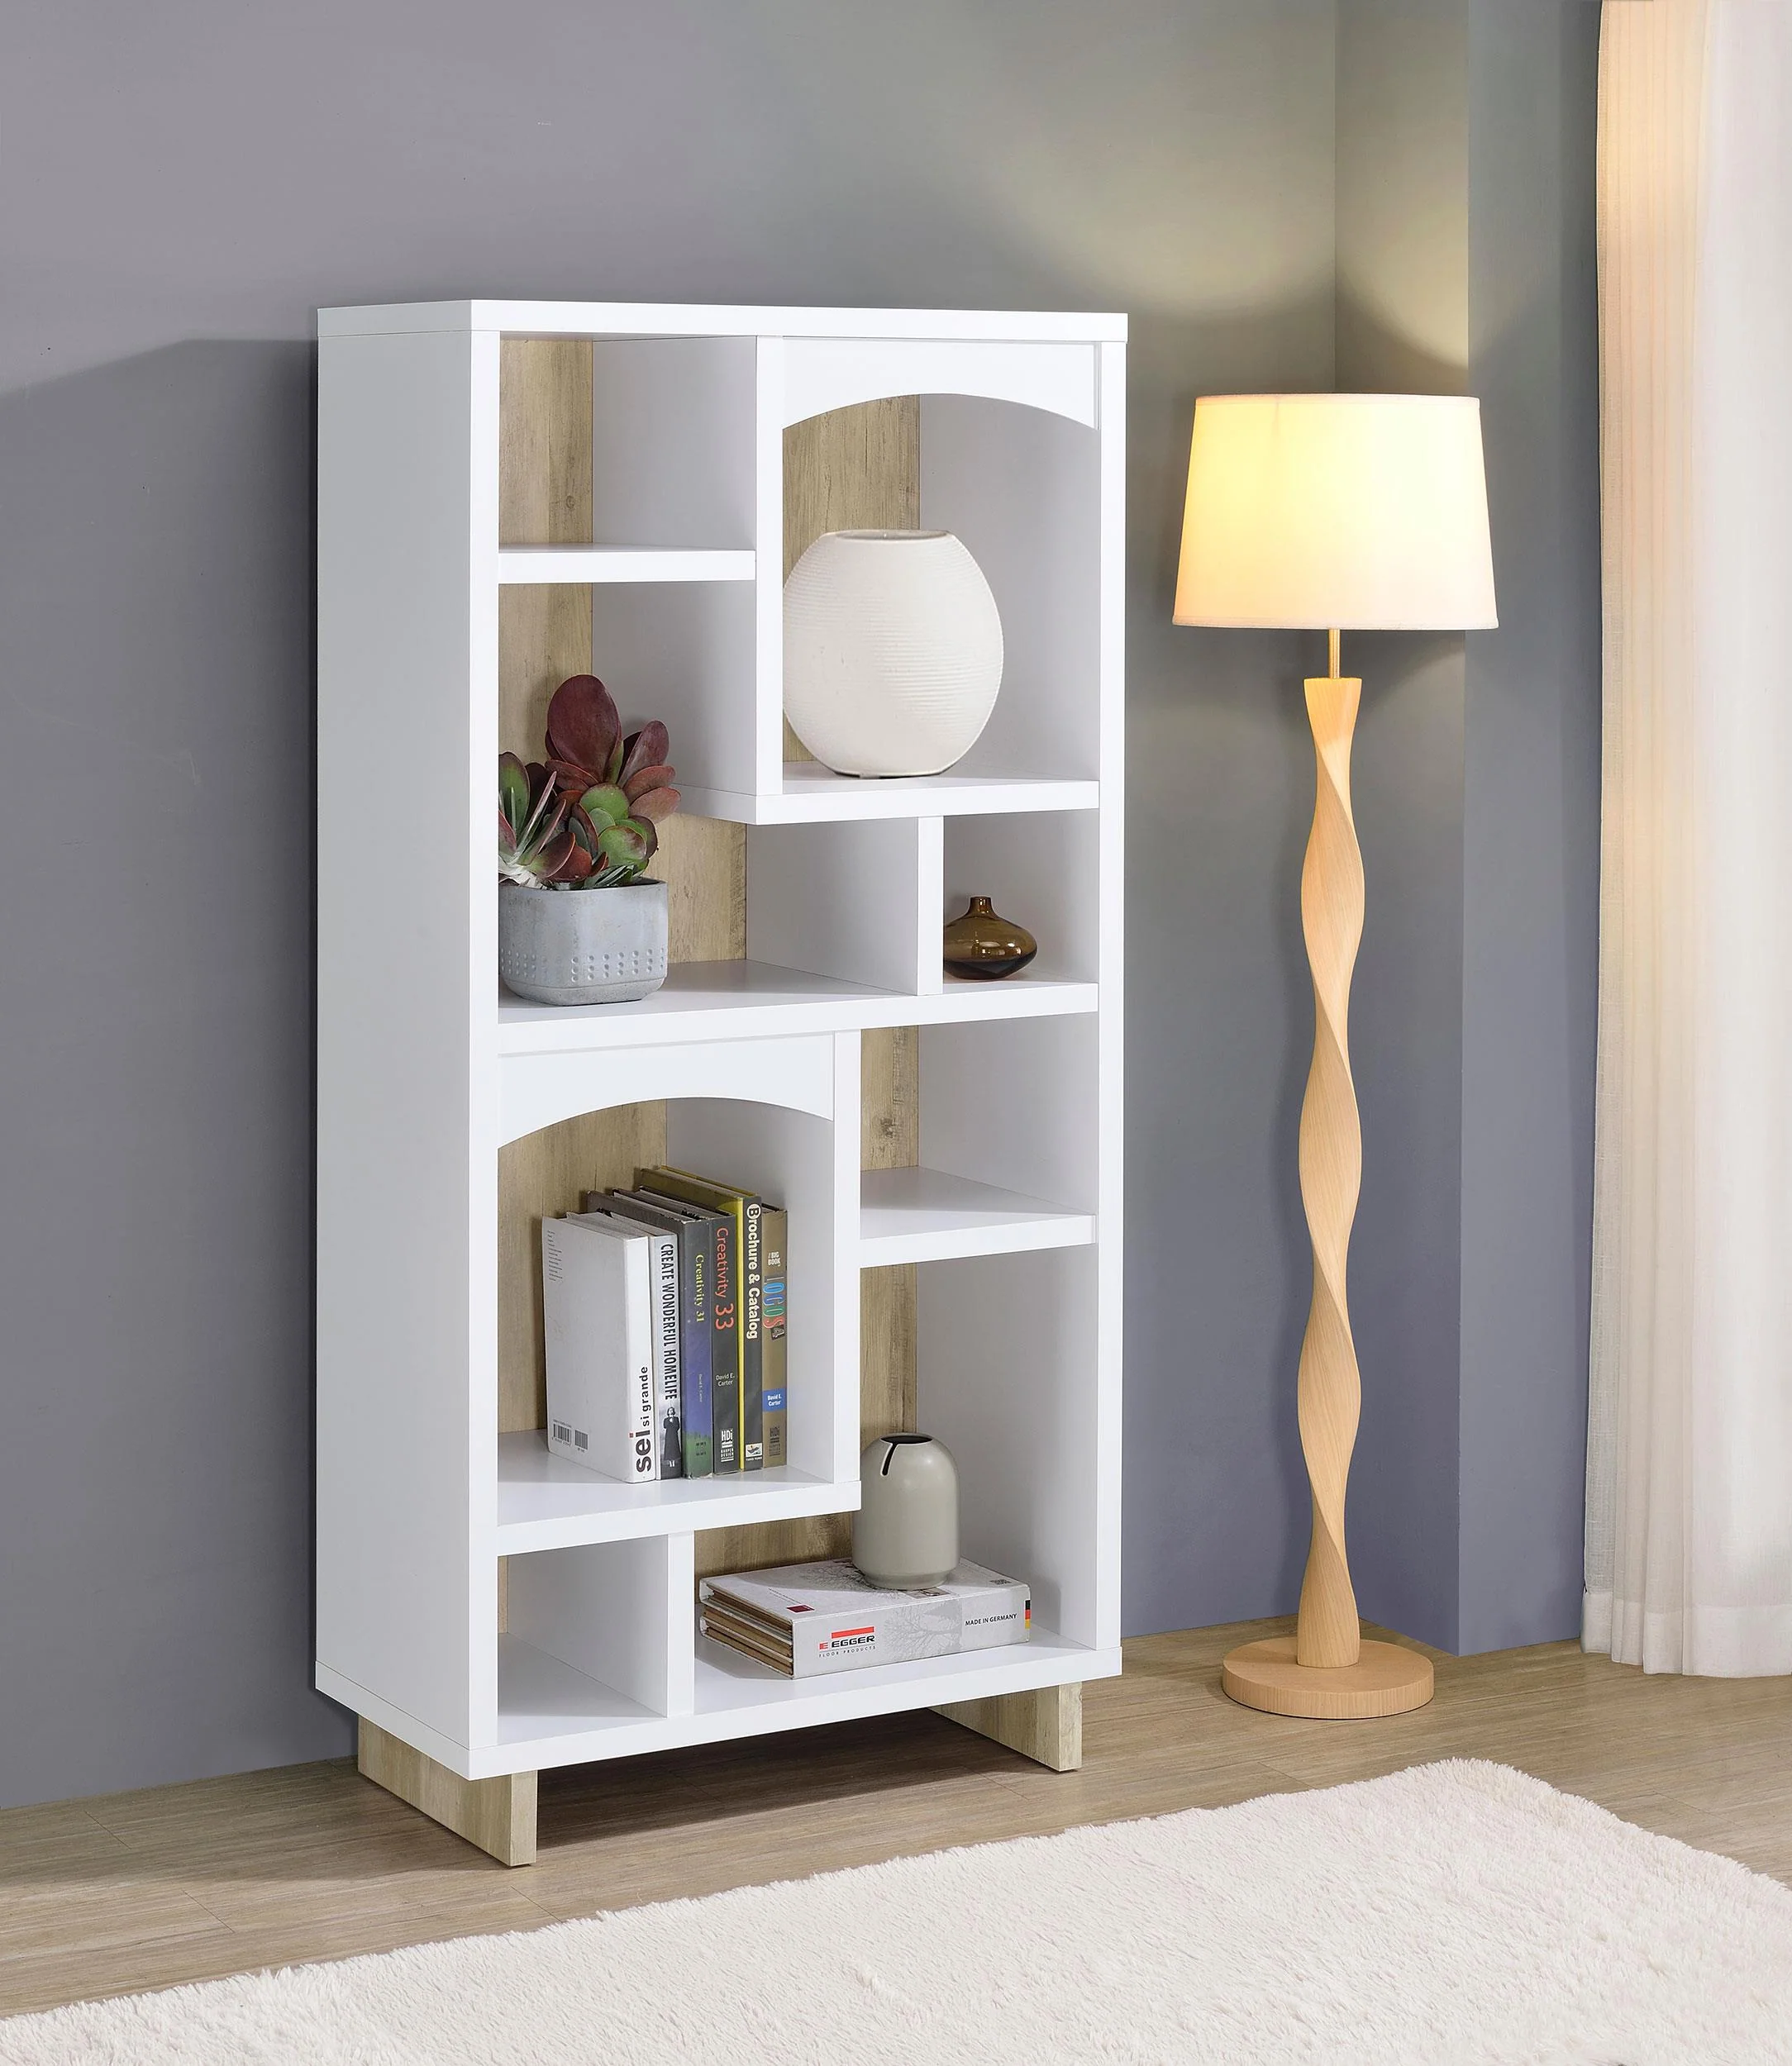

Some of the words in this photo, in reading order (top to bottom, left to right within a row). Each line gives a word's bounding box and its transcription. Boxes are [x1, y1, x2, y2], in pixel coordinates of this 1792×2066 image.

[746, 1203, 761, 1270] Brochure
[661, 1244, 674, 1280] CREATE
[715, 1227, 729, 1298] Creativity
[748, 1273, 760, 1284] &
[695, 1254, 704, 1308] Creativity
[662, 1283, 676, 1347] WONDERFUL
[696, 1311, 704, 1322] 31
[715, 1303, 734, 1331] 33
[746, 1288, 760, 1340] Catalog
[639, 1366, 651, 1412] grande
[664, 1350, 677, 1400] HOMELIFE
[641, 1416, 650, 1427] si
[721, 1429, 733, 1441] HDi
[630, 1430, 651, 1473] sei
[989, 1613, 1018, 1622] GERMANY
[832, 1635, 875, 1648] EGGER
[843, 1645, 875, 1654] PRODUCTS
